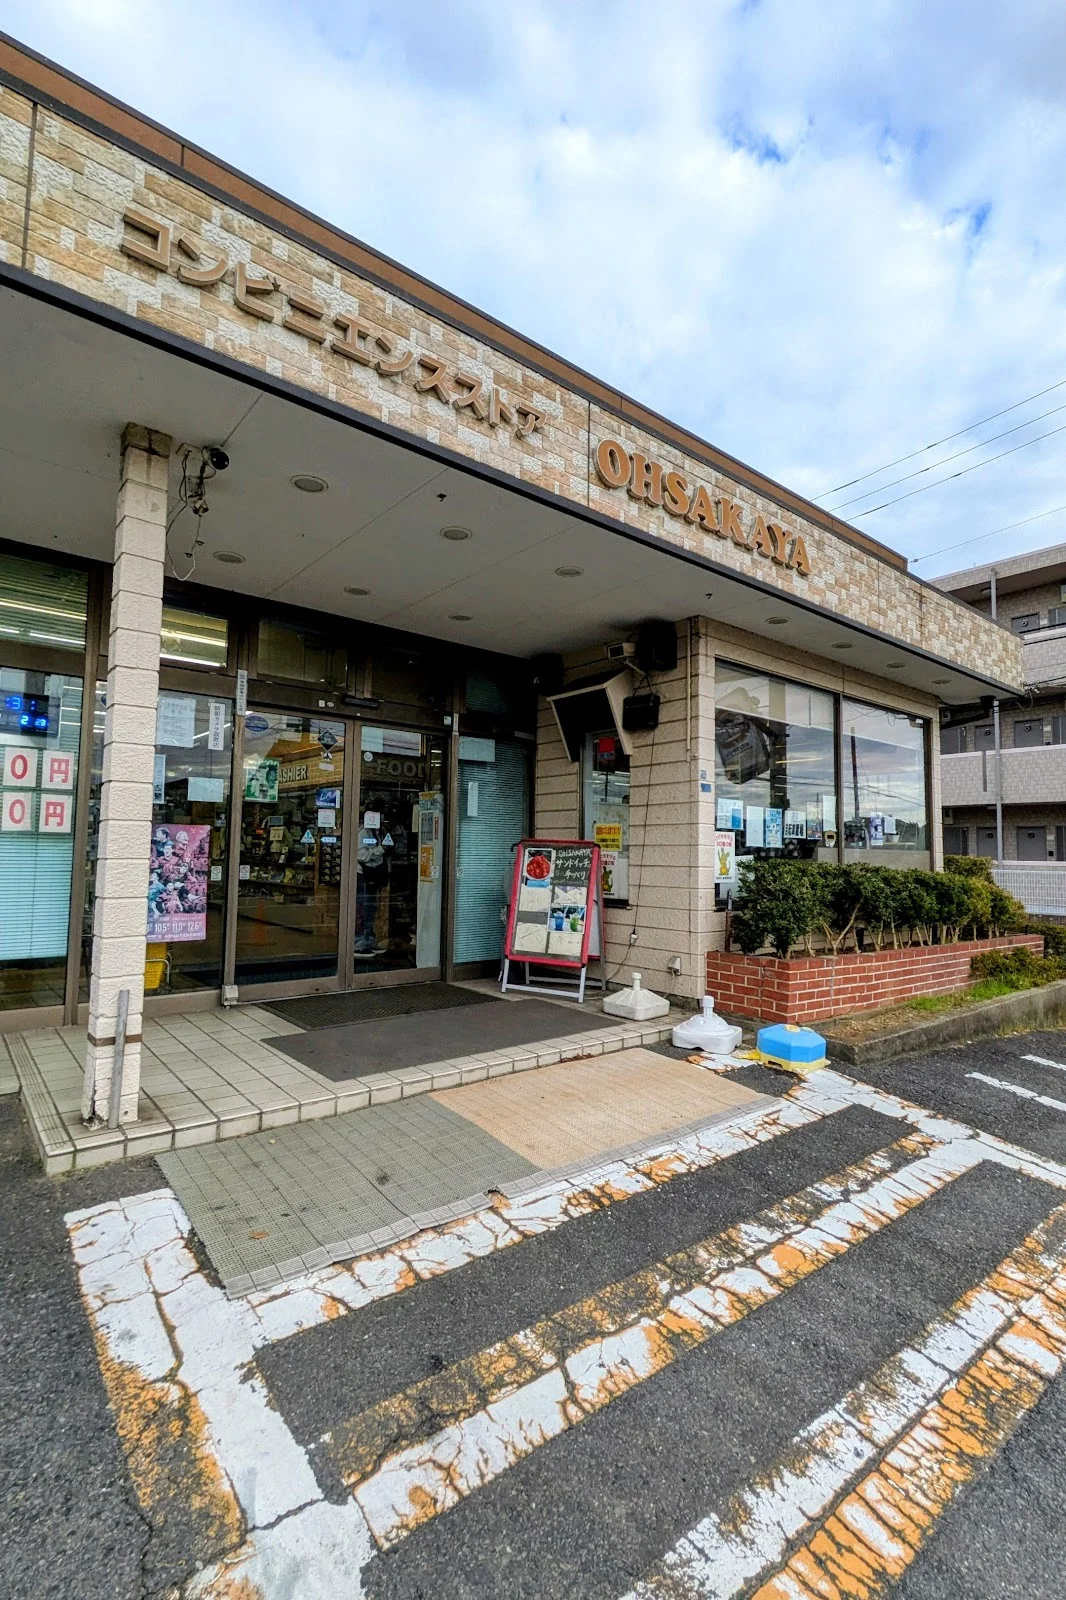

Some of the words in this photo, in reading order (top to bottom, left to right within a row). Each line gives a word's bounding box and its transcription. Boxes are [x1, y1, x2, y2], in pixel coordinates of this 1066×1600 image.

[120, 207, 547, 438] コンビニエンスストア
[594, 439, 812, 576] OHSAKAYA
[556, 858, 590, 868] サンドイッチ
